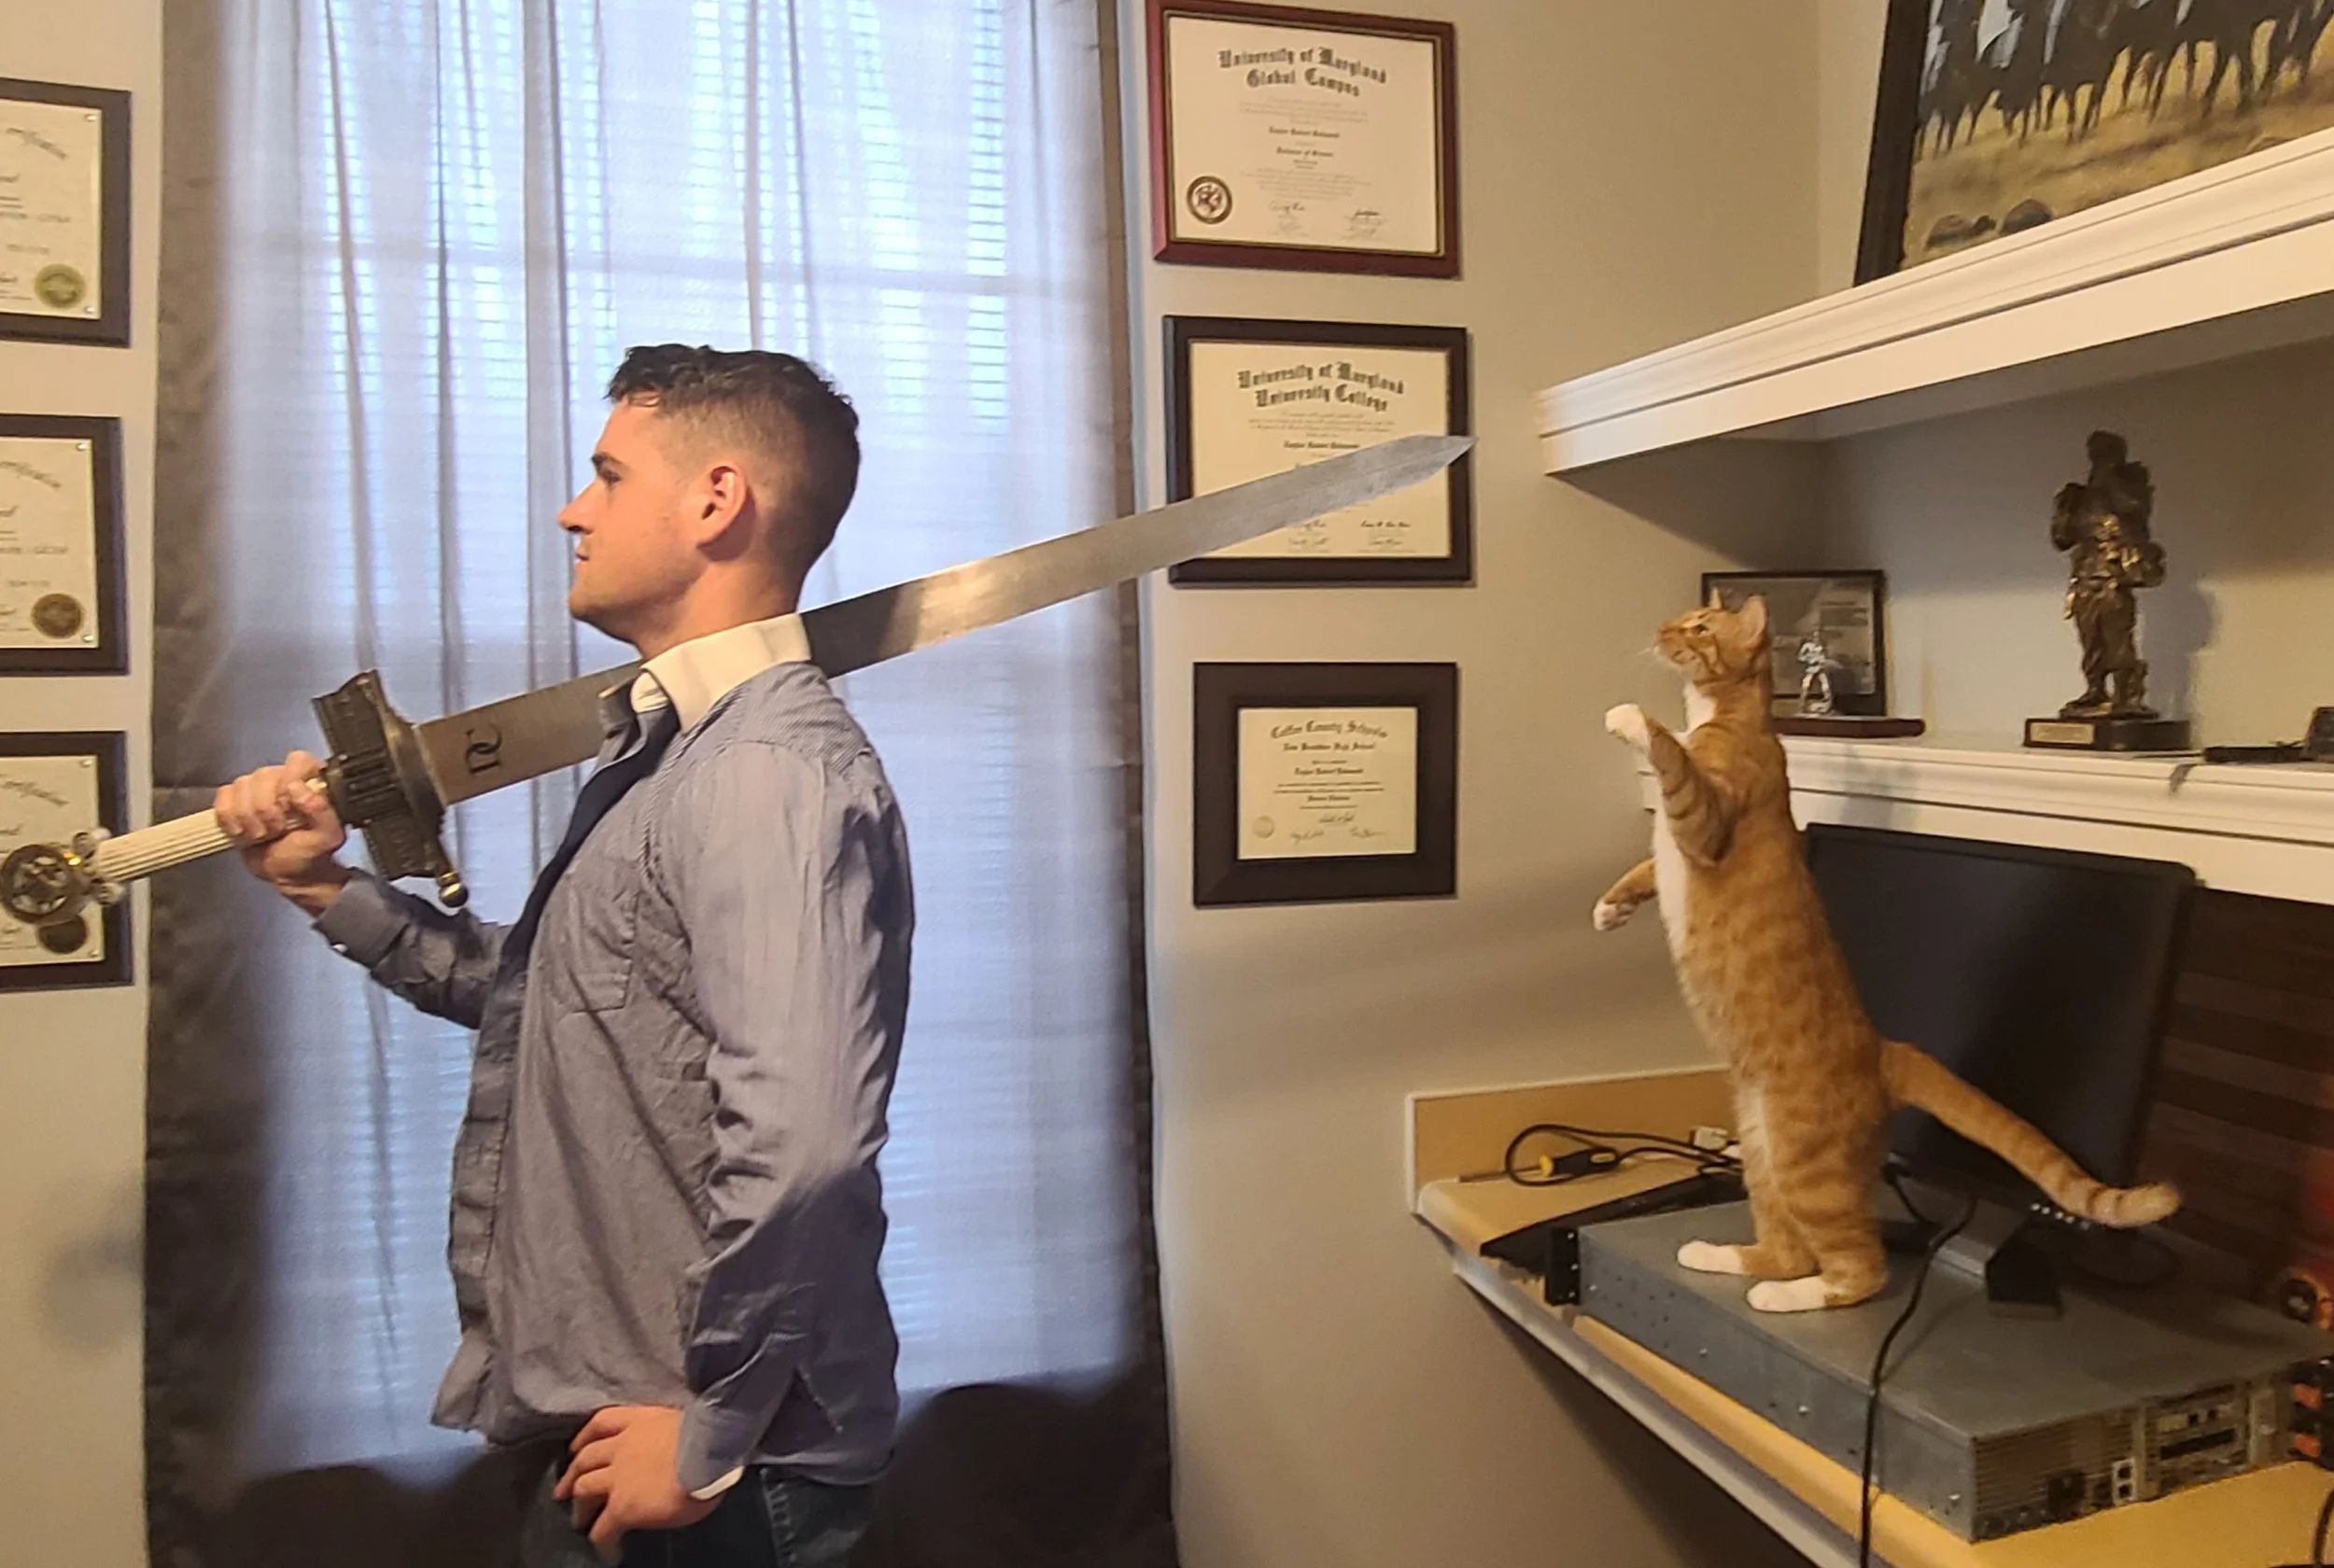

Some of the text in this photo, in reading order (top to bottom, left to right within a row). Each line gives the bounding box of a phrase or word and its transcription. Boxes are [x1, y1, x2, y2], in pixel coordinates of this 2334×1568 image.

[1218, 48, 1294, 68] University
[1300, 49, 1314, 63] of
[1238, 364, 1313, 388] University
[1318, 363, 1332, 378] of
[1255, 384, 1388, 412] University College
